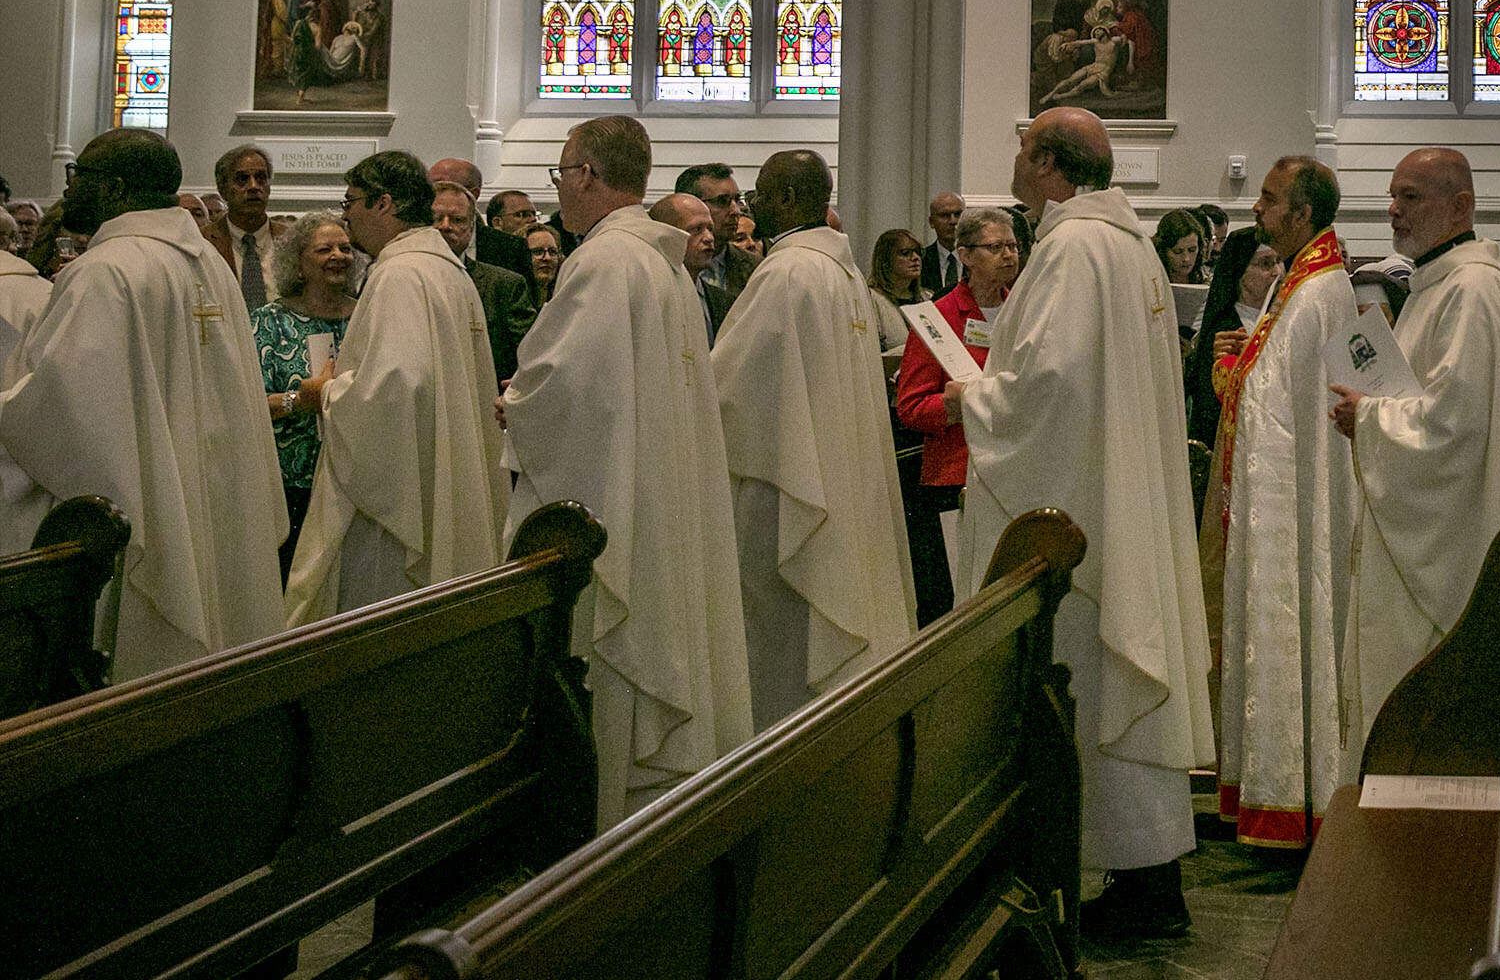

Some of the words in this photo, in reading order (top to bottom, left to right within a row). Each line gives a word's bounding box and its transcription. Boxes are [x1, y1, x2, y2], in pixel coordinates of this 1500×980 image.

[281, 153, 304, 162] JESUS
[315, 153, 348, 161] PLACED
[285, 161, 296, 169] IN
